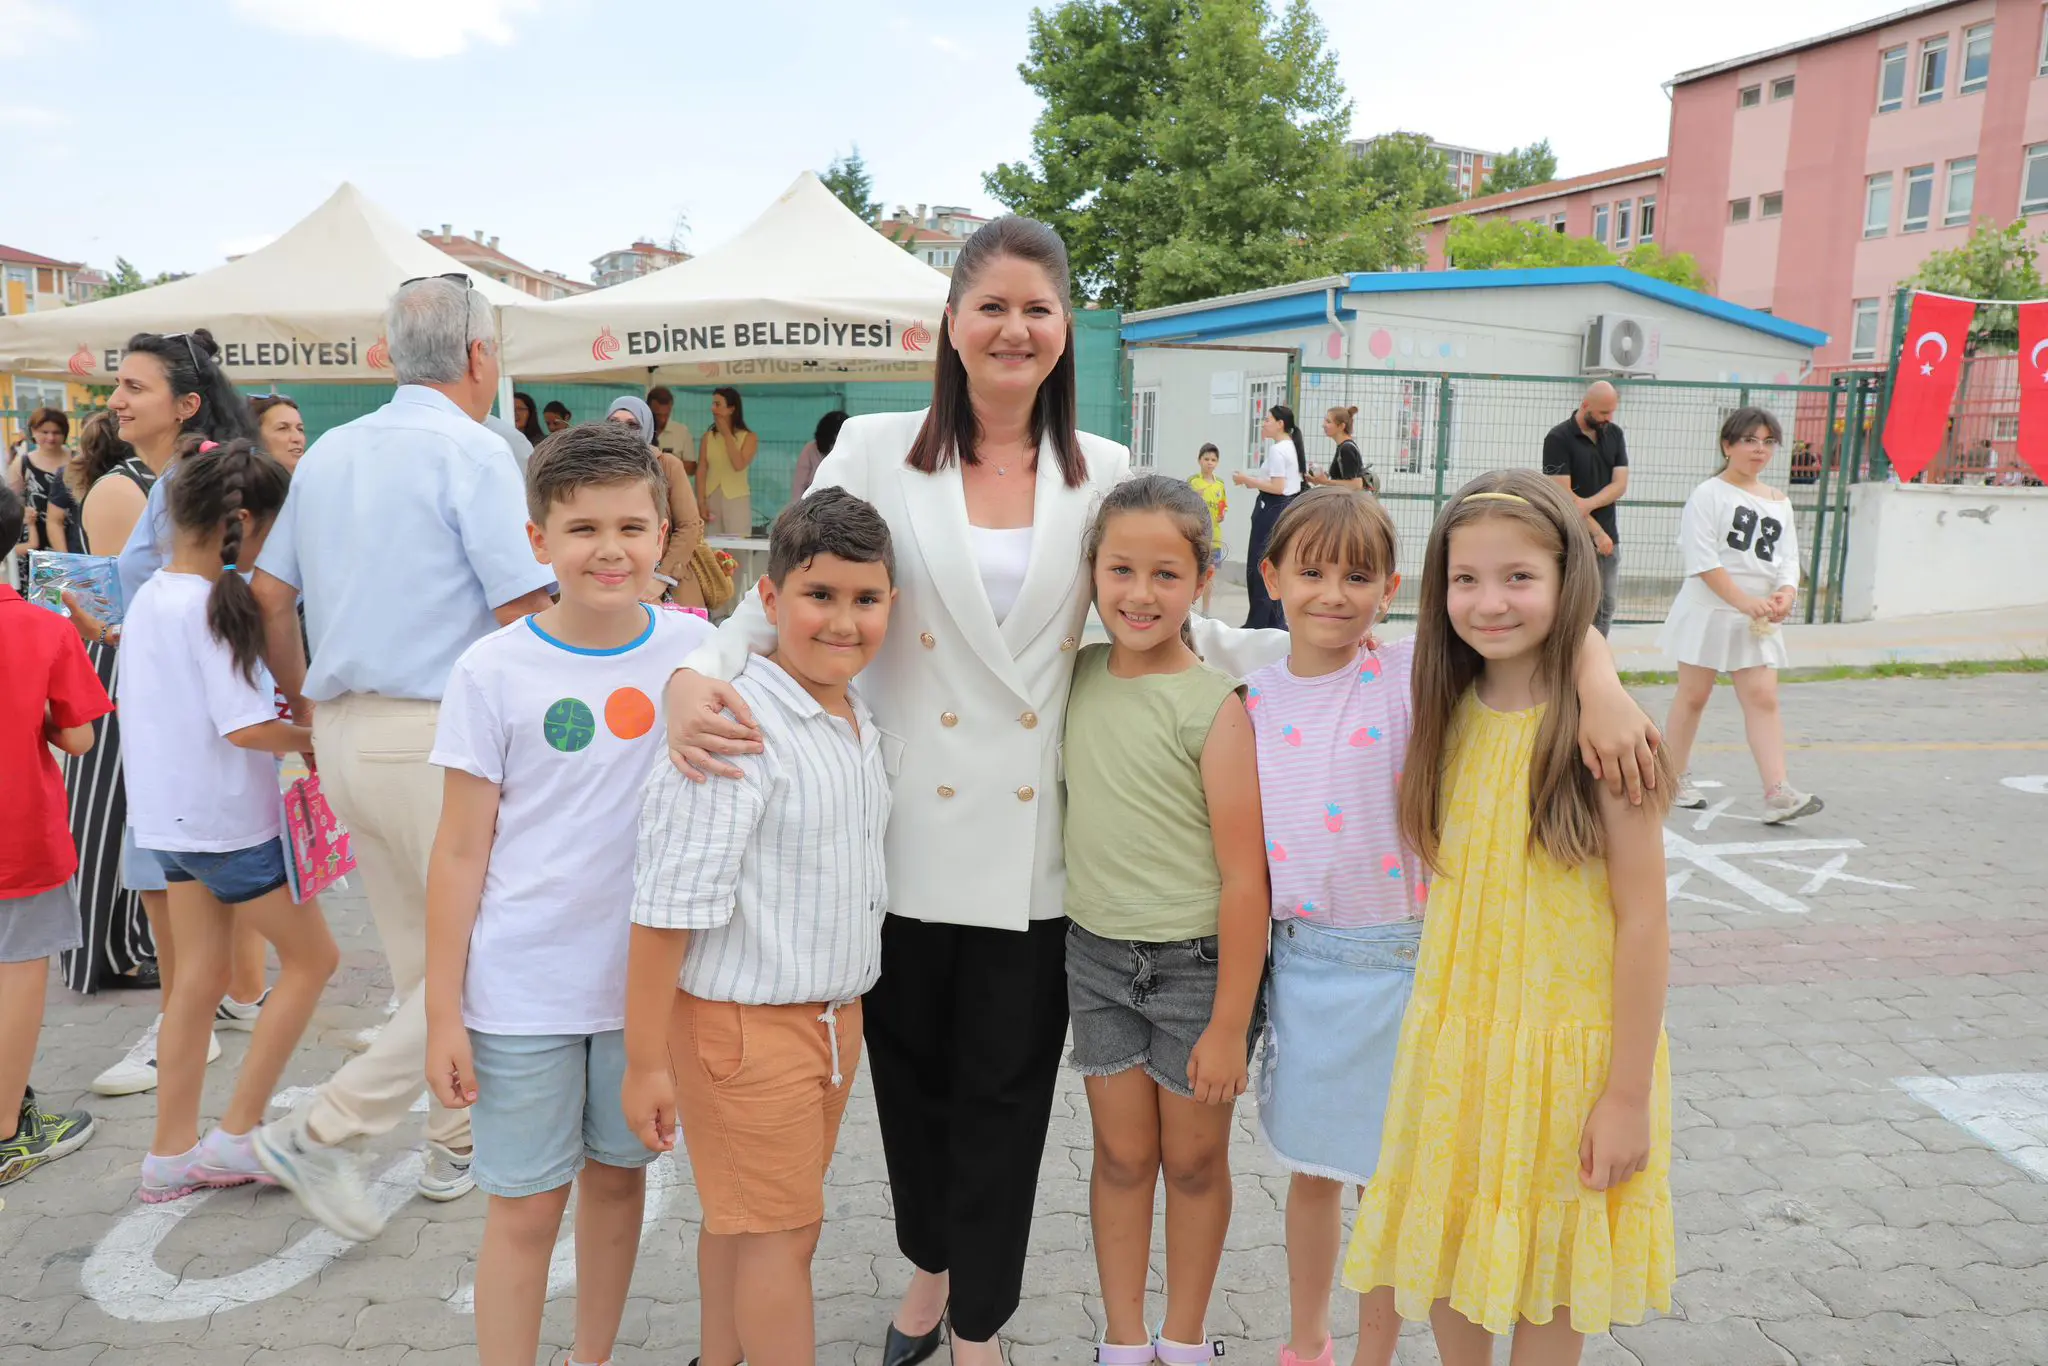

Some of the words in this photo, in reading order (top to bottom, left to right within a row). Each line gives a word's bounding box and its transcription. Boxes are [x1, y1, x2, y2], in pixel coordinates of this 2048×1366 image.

[627, 323, 726, 355] EDİRNE
[734, 317, 892, 347] BELEDİYESİ
[1727, 505, 1782, 563] 98
